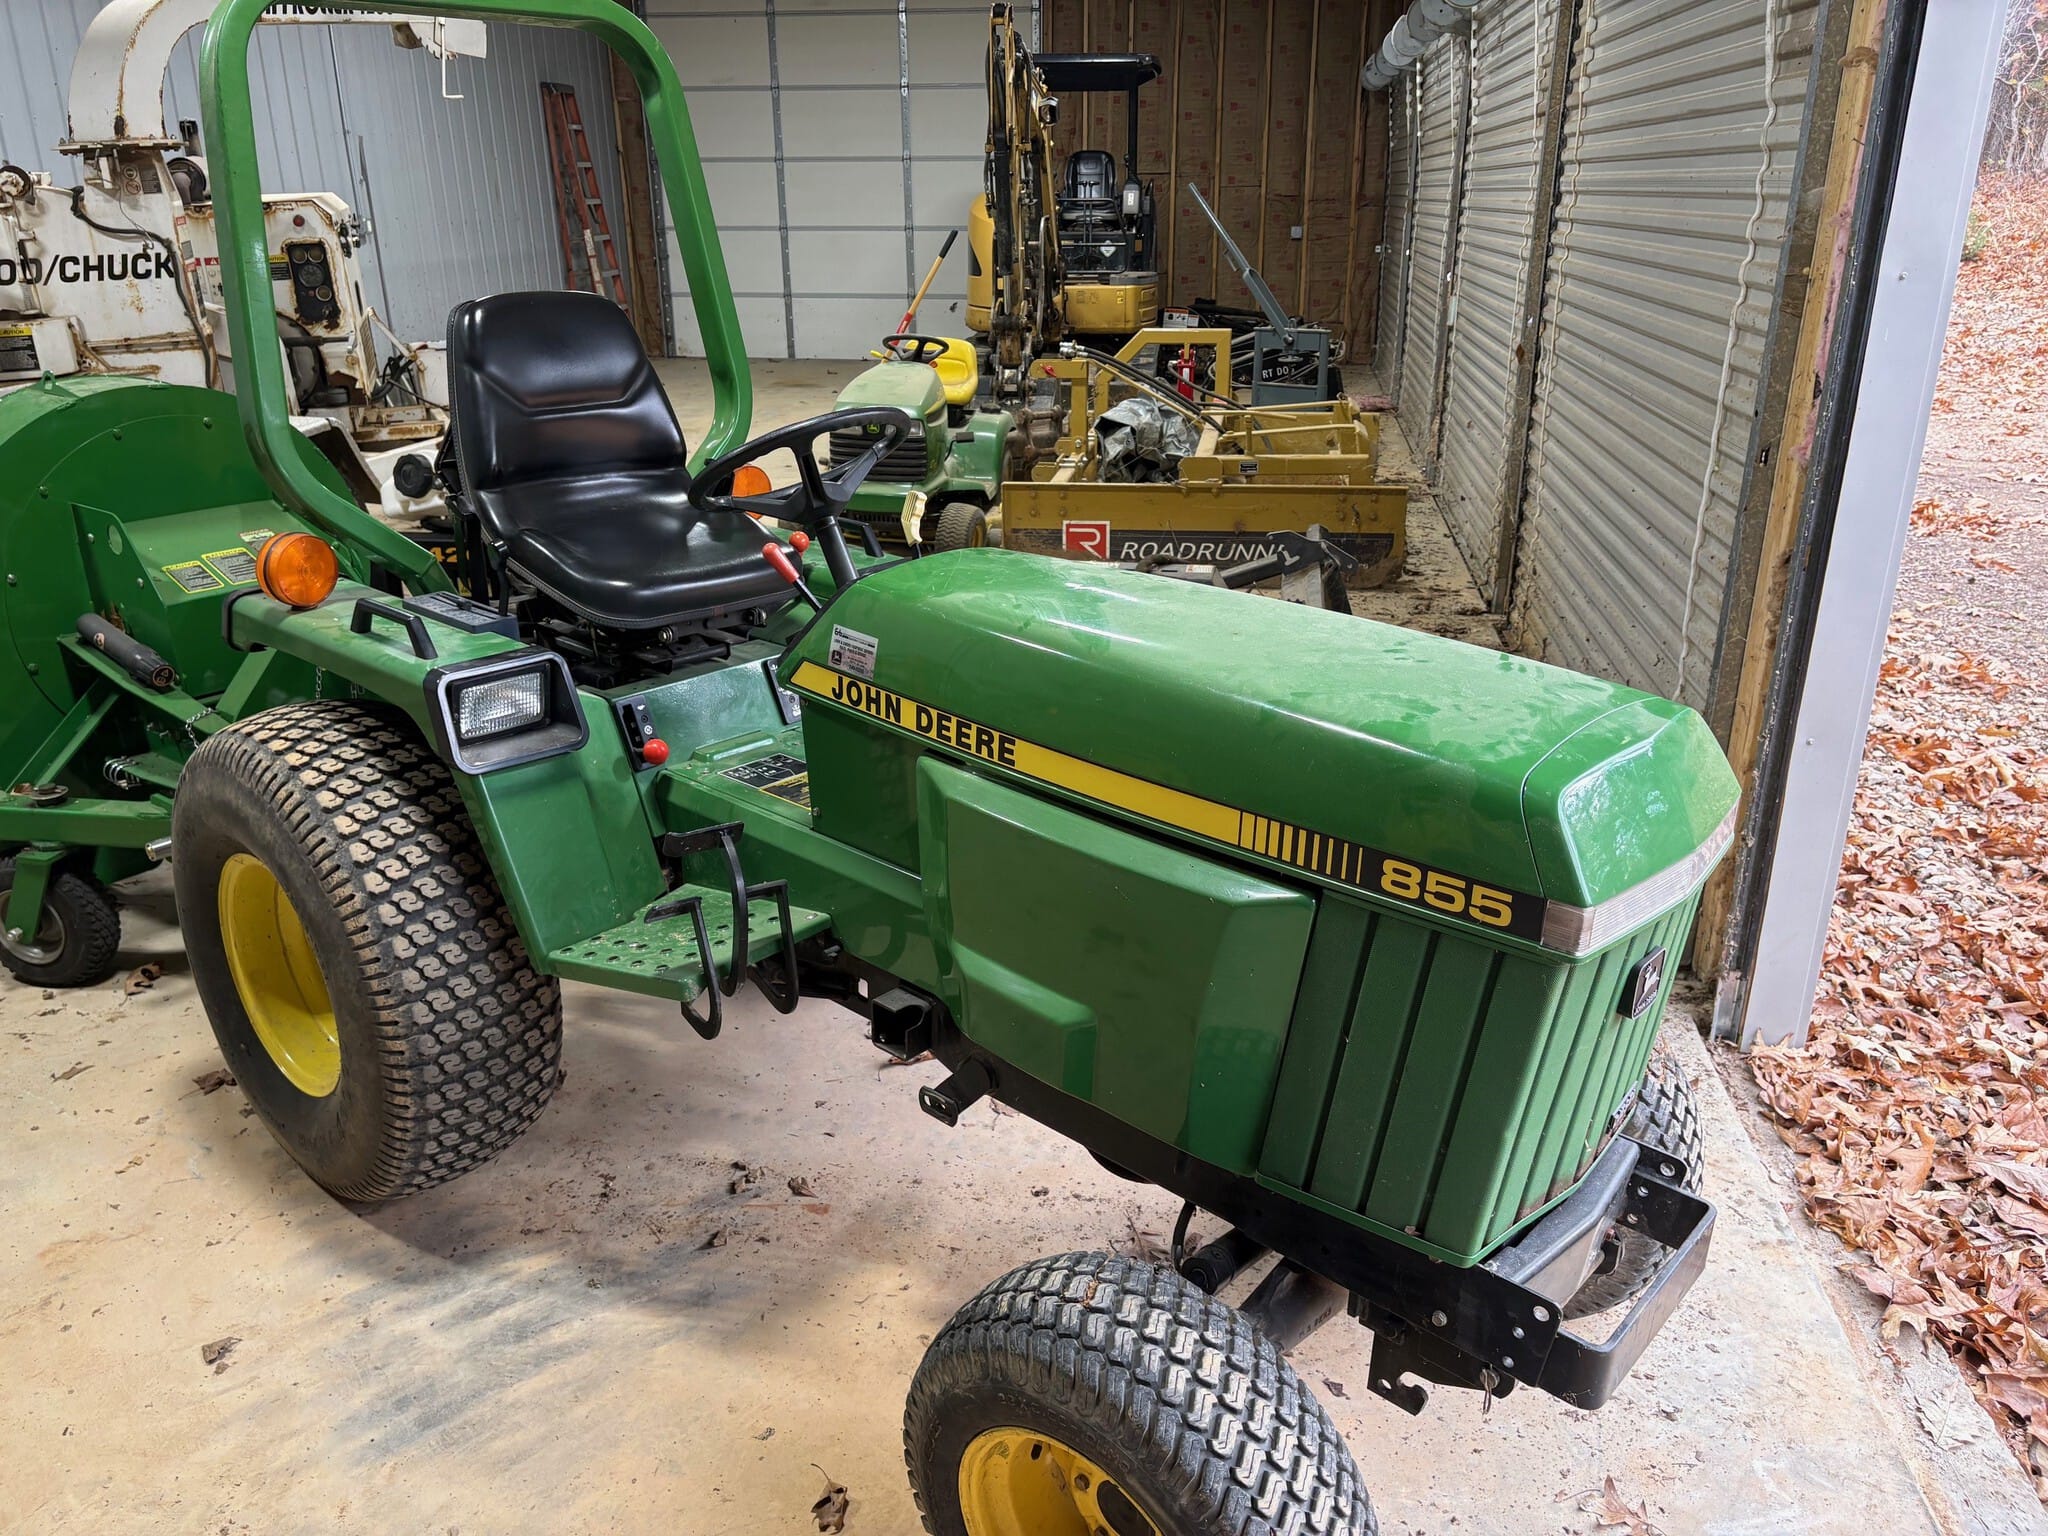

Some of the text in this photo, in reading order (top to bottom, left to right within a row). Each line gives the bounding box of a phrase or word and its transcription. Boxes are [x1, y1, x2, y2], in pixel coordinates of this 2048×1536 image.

[832, 676, 1016, 767] JOHN DEERE
[1381, 859, 1513, 927] 855
